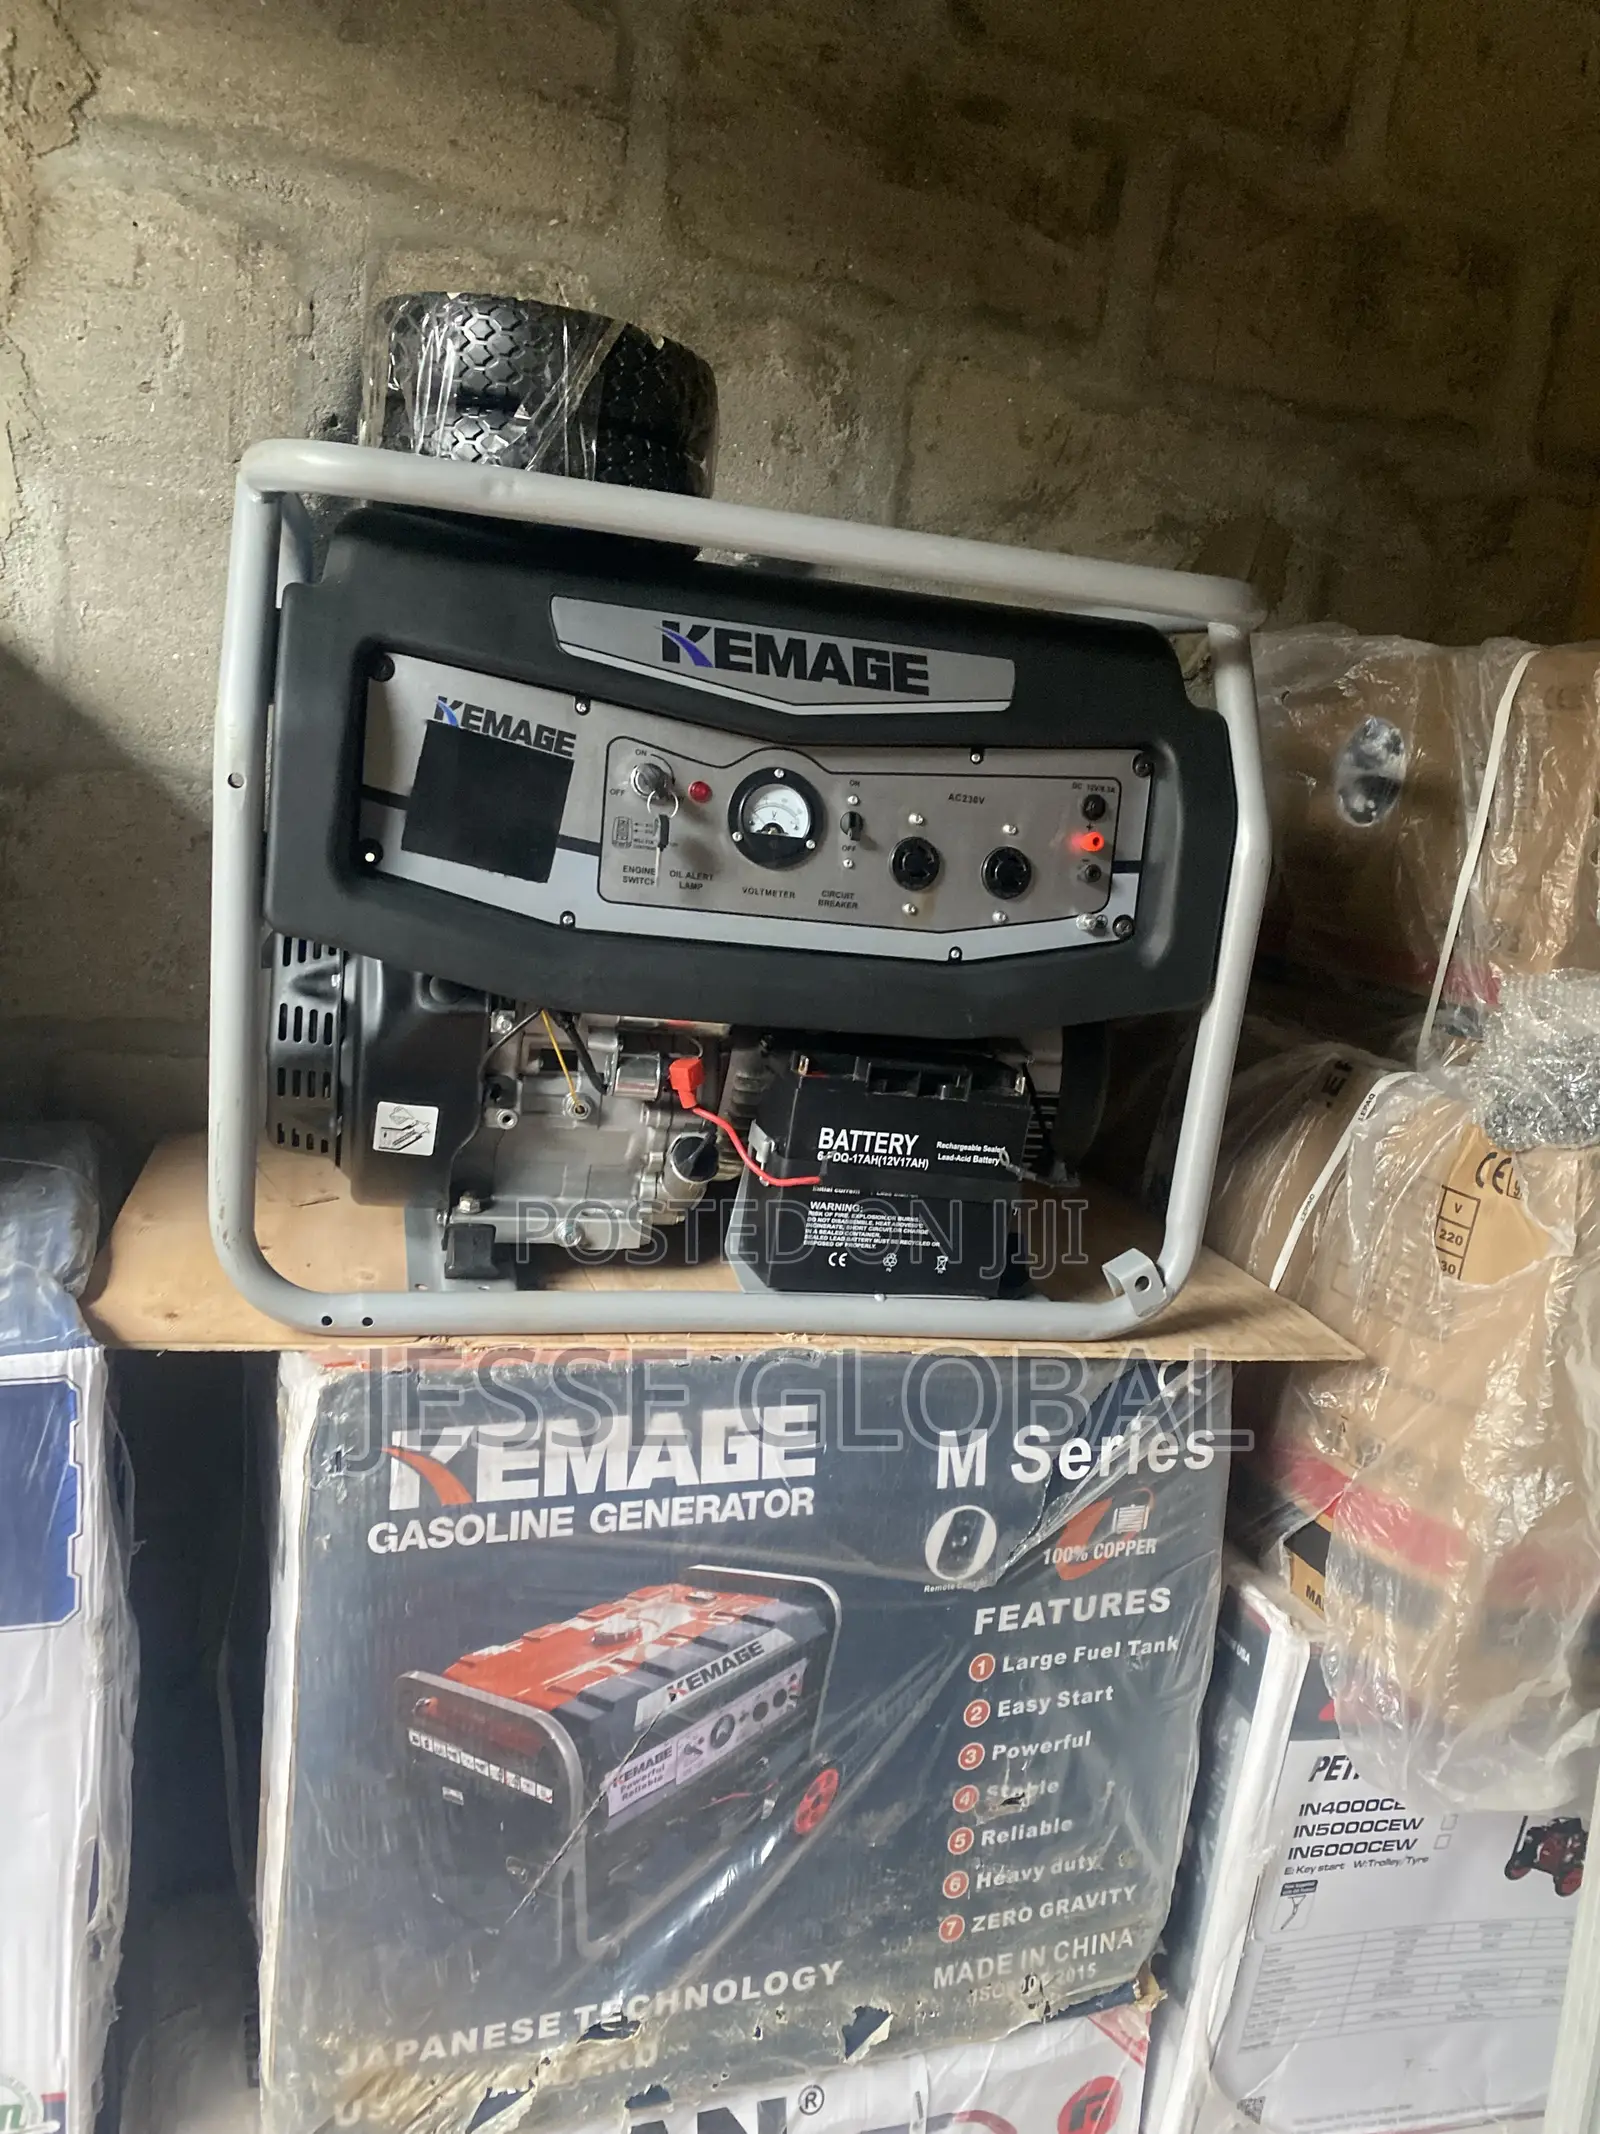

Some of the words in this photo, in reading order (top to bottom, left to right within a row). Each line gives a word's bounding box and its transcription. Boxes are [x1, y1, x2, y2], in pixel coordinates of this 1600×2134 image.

[653, 620, 929, 696] KEMAGE
[434, 695, 576, 757] KEMAGE
[635, 748, 647, 757] ON
[609, 788, 625, 797] OFF
[849, 779, 860, 788] ON
[841, 844, 857, 852] OFF
[622, 864, 656, 876] ENGINE
[669, 869, 683, 880] OIL
[686, 871, 714, 881] ALERT
[679, 881, 704, 890] LAMP
[742, 886, 796, 899] VOLTMETER
[821, 889, 855, 899] CIRCUIT
[817, 899, 859, 910] BREAKER
[817, 1126, 919, 1156] BATTERY
[936, 1141, 982, 1152] Rechargeable
[937, 1152, 971, 1164] Lead-Acid
[972, 1154, 1001, 1167] Battery
[1476, 1152, 1512, 1195] CE
[808, 1210, 823, 1218] RISK
[810, 1200, 863, 1213] WARNING:
[1438, 1228, 1463, 1246] 220
[1438, 1259, 1456, 1275] 30
[382, 1404, 817, 1511] KEMAGE
[936, 1428, 987, 1490] M
[1010, 1425, 1216, 1484] Series
[367, 1506, 574, 1554] GASOLINE
[589, 1487, 815, 1534] GENERATOR
[1043, 1544, 1088, 1567] 100%
[1093, 1538, 1157, 1560] COPPER
[1305, 1585, 1325, 1611] MA
[974, 1587, 1172, 1635] FEATURES
[1002, 1651, 1066, 1674] Large
[1073, 1641, 1121, 1663] Fuel
[1127, 1635, 1179, 1656] Tank
[667, 1641, 765, 1702] KEMAGE
[997, 1697, 1050, 1719] Easy
[1056, 1686, 1114, 1708] Start
[991, 1731, 1091, 1761] Powerful
[980, 1818, 1073, 1847] Reliable
[1293, 1817, 1425, 1838] IN5000CEW
[1287, 1838, 1418, 1860] IN6000CEW
[976, 1864, 1045, 1890] Heavy
[1049, 1853, 1099, 1877] duty
[1295, 1864, 1316, 1875] Key
[1317, 1863, 1345, 1872] start
[971, 1907, 1033, 1934] ZERO
[1039, 1884, 1138, 1919] GRAVITY
[933, 1952, 1014, 1989] MADE
[1020, 1945, 1046, 1970] IN
[1053, 1927, 1133, 1963] CHINA
